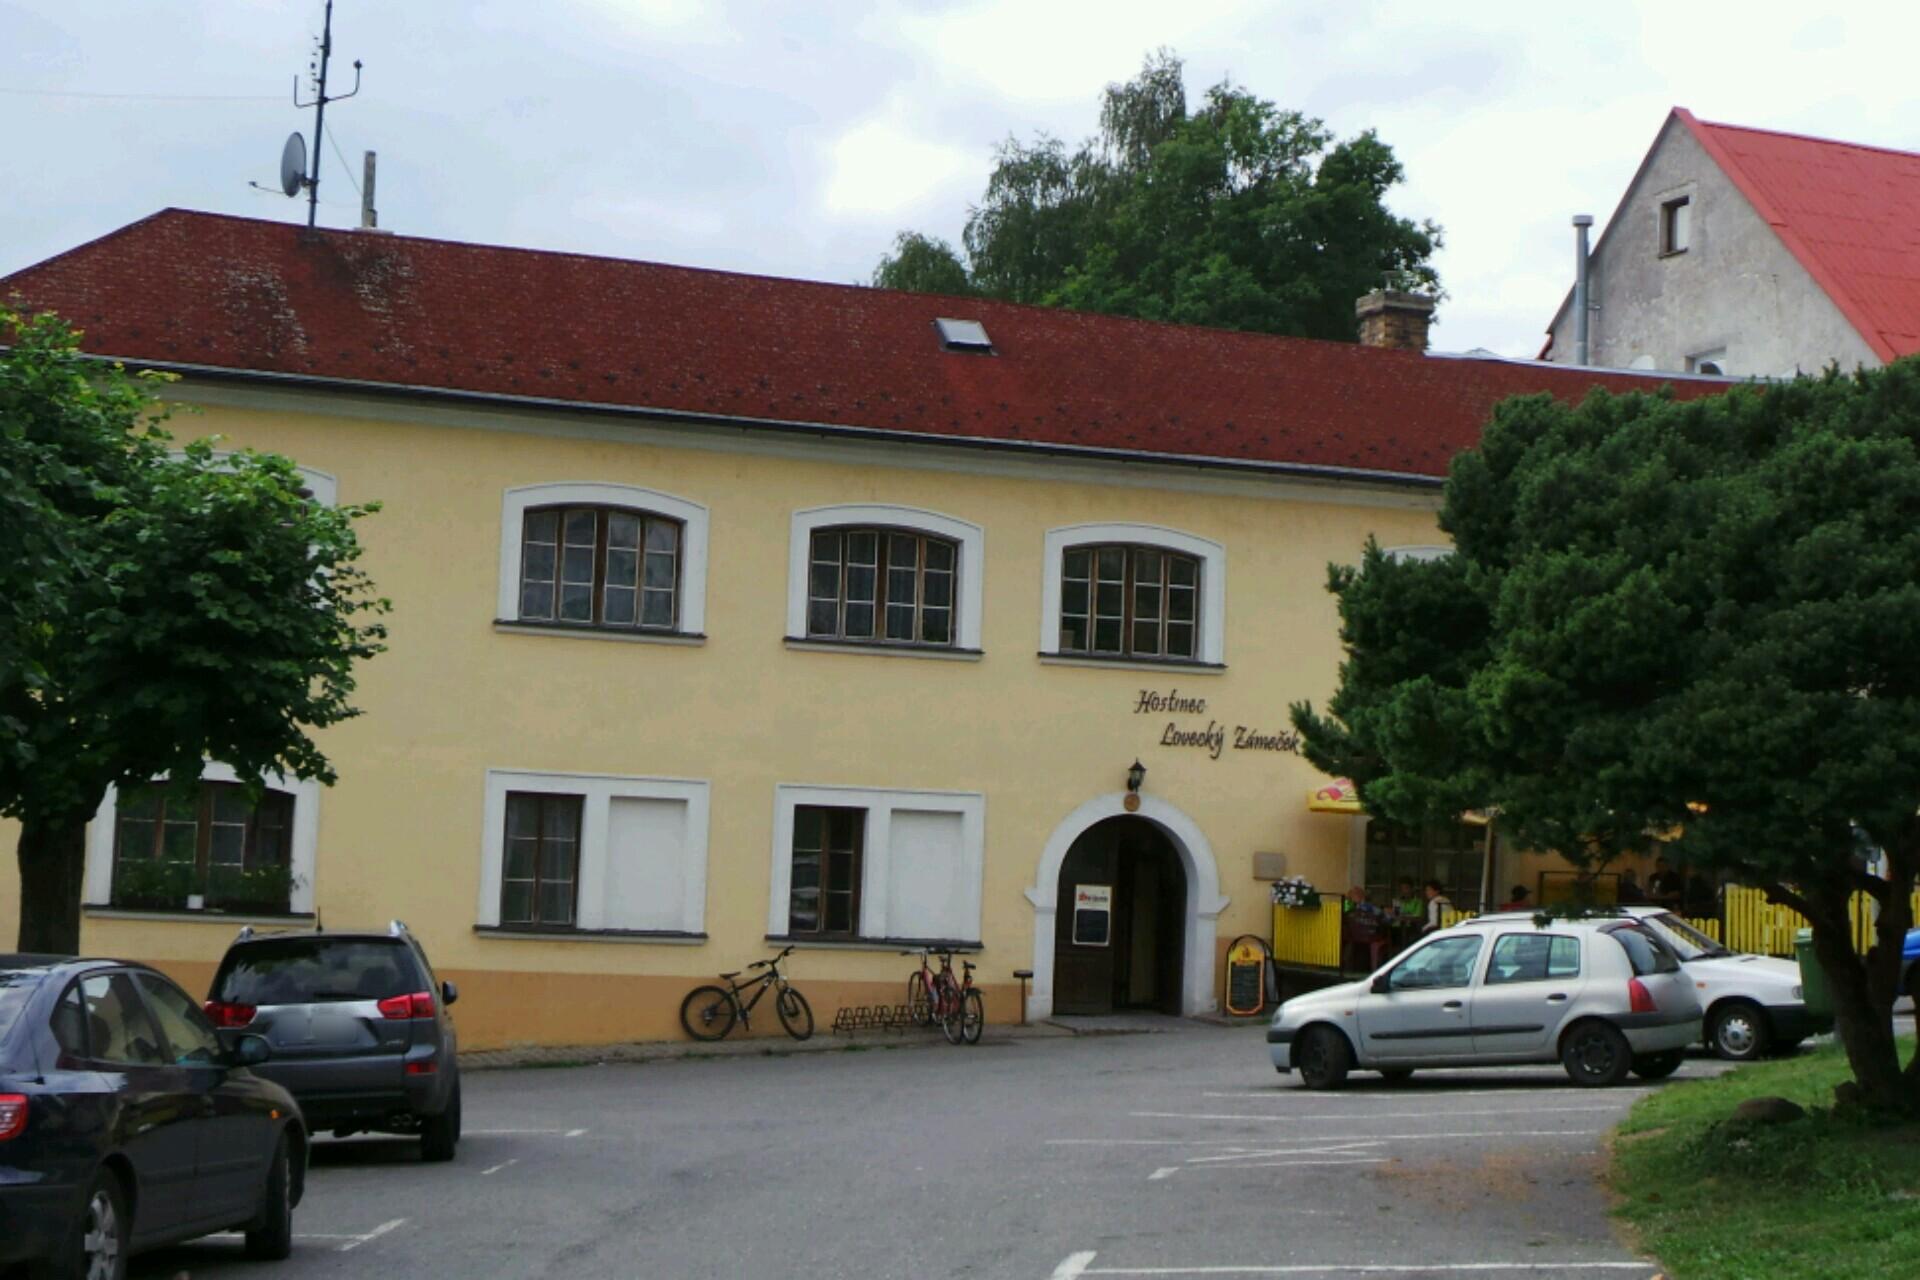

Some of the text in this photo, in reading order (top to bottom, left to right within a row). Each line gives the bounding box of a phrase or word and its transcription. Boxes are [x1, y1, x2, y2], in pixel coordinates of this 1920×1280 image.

[1133, 688, 1206, 714] Hostinec
[1159, 720, 1301, 759] Lovecký Zámeček
